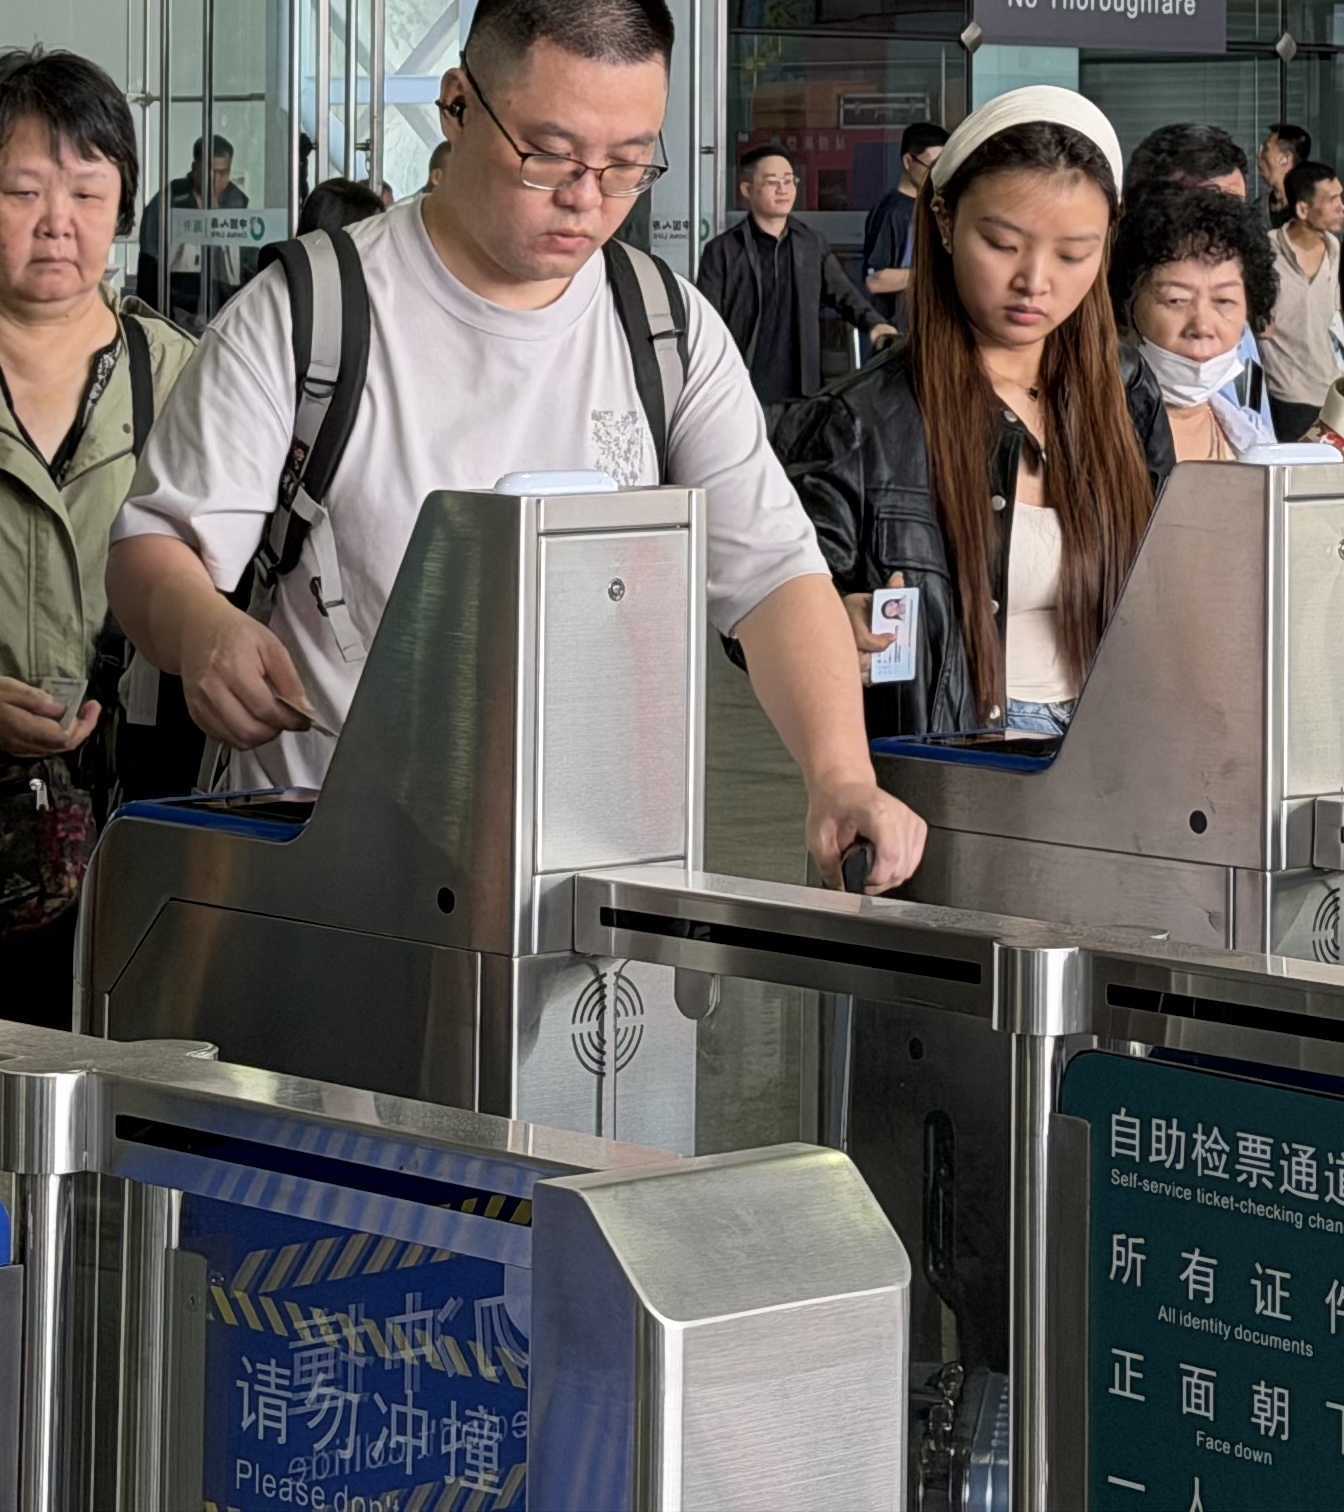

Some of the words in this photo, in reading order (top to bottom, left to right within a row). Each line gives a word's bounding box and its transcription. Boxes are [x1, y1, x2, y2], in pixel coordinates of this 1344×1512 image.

[1111, 1169, 1191, 1200] Self-service
[1196, 1188, 1304, 1230] ticket-checking
[1158, 1305, 1175, 1323] All
[1180, 1310, 1231, 1340] identity
[1234, 1324, 1313, 1356] documents
[236, 1356, 504, 1495] 请勿冲撞
[1197, 1431, 1230, 1454] Face
[1235, 1442, 1272, 1465] down
[236, 1458, 325, 1510] Please
